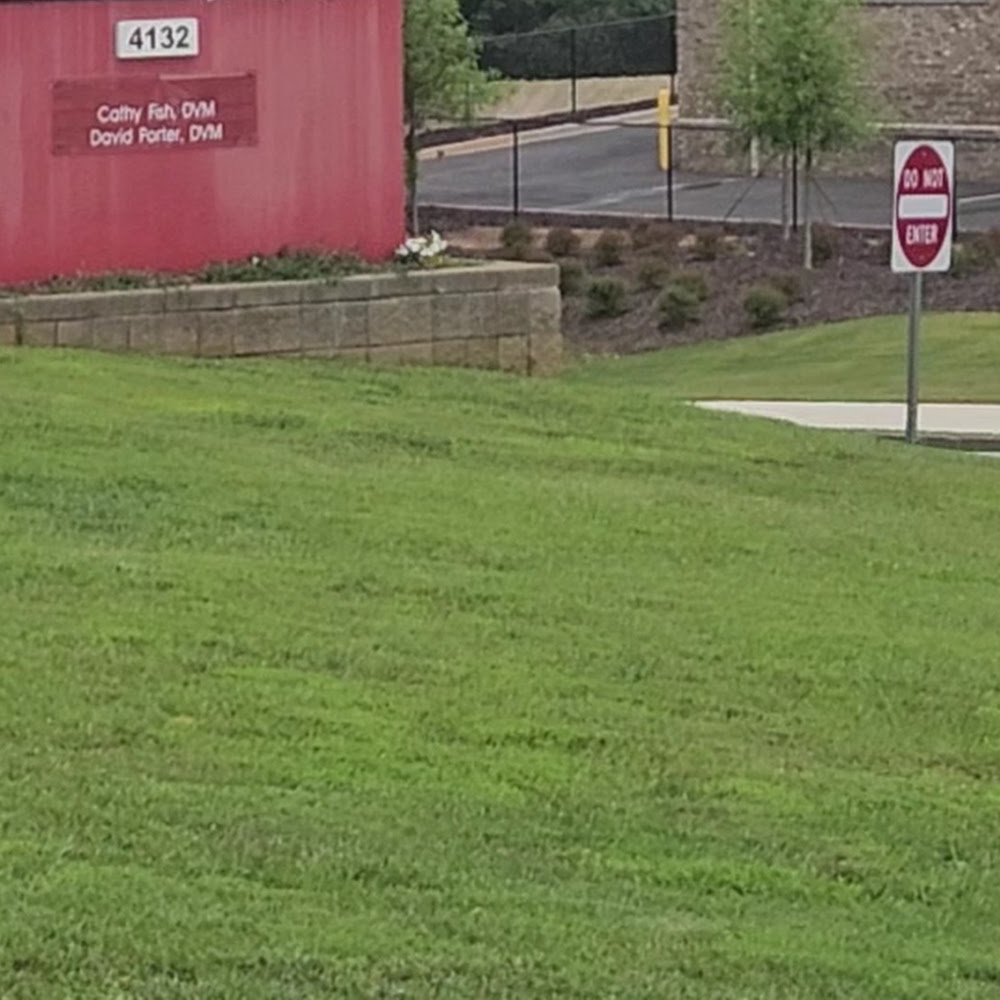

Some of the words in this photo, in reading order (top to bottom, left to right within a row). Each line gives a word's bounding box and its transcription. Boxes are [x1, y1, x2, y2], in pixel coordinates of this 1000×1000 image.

[128, 25, 190, 50] 4132
[97, 104, 142, 124] Cathy
[181, 100, 216, 119] DVM
[89, 127, 134, 147] David
[189, 123, 223, 142] DVM
[903, 168, 919, 188] DO
[923, 167, 944, 187] NOT
[905, 224, 938, 245] ENTER
